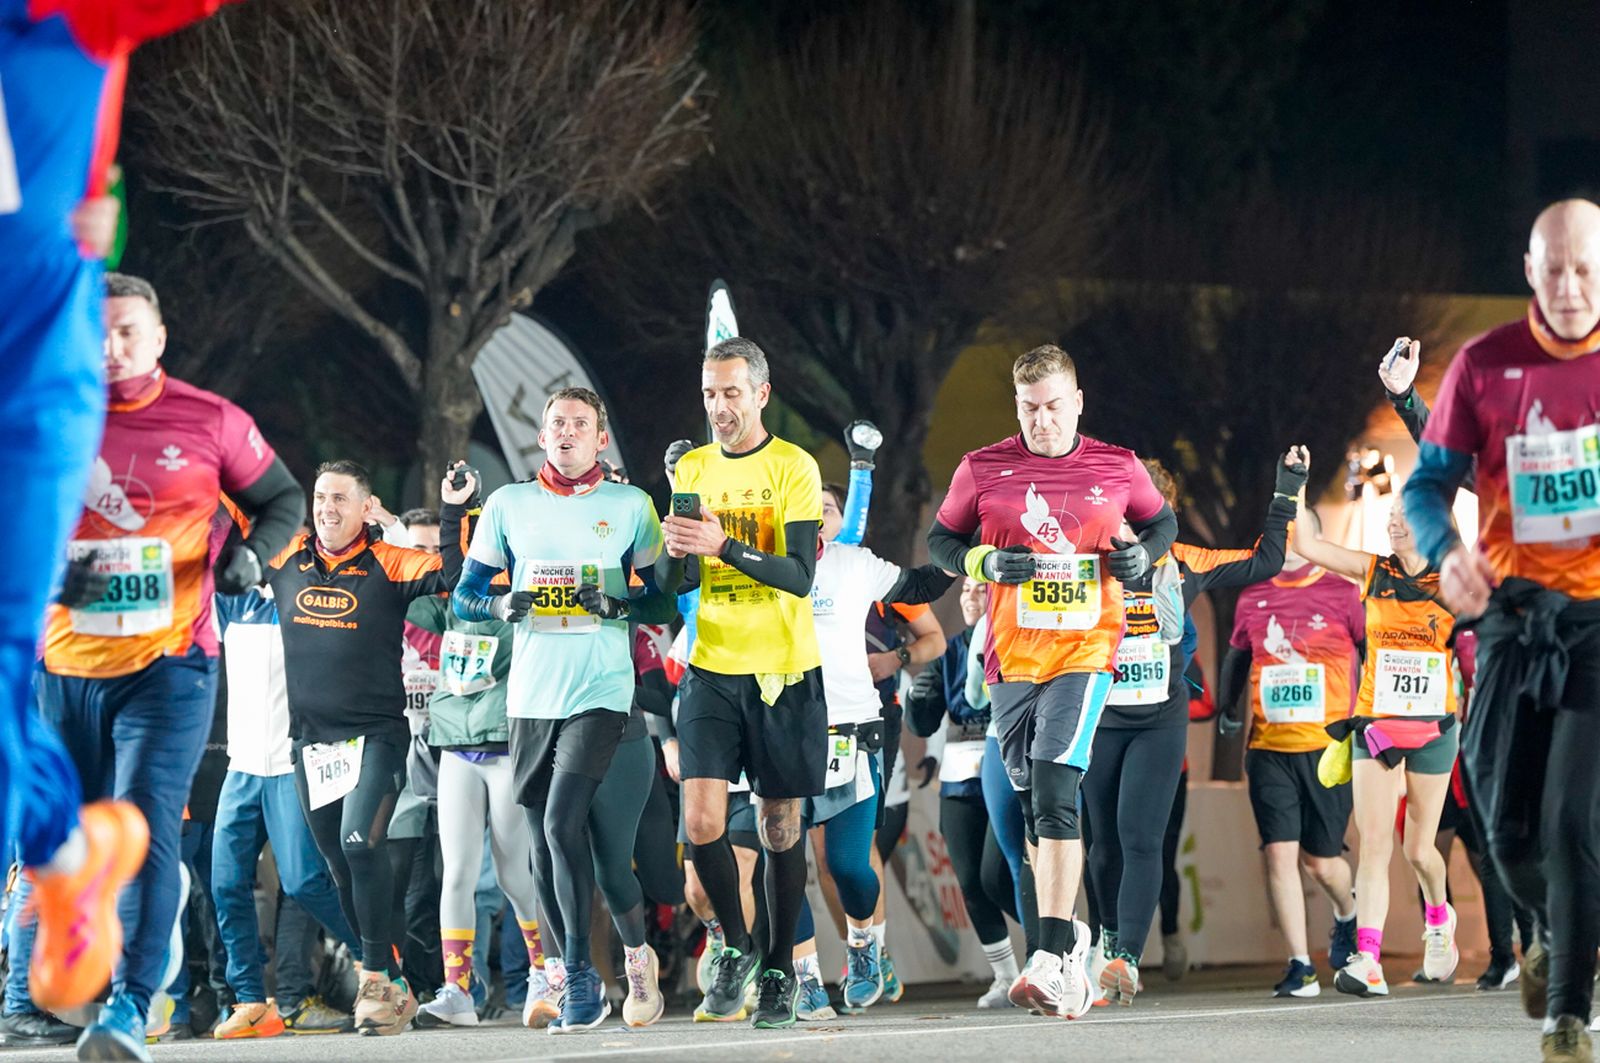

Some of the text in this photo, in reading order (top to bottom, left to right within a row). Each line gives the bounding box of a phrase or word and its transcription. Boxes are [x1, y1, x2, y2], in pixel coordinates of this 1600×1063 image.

[1529, 468, 1597, 506] 7850
[1037, 522, 1059, 543] 43
[540, 567, 575, 576] NOCHE DE
[1032, 572, 1044, 580] AN
[1037, 562, 1072, 571] NOCHE DE
[100, 574, 159, 603] 398
[532, 577, 548, 585] SAN
[303, 594, 349, 609] GALBIS
[534, 586, 577, 608] 535
[1032, 581, 1087, 604] 5354
[1126, 604, 1157, 614] ALBI
[1118, 662, 1164, 683] 3956
[1271, 685, 1312, 703] 8266
[1392, 674, 1430, 694] 7317
[317, 759, 351, 784] 7485
